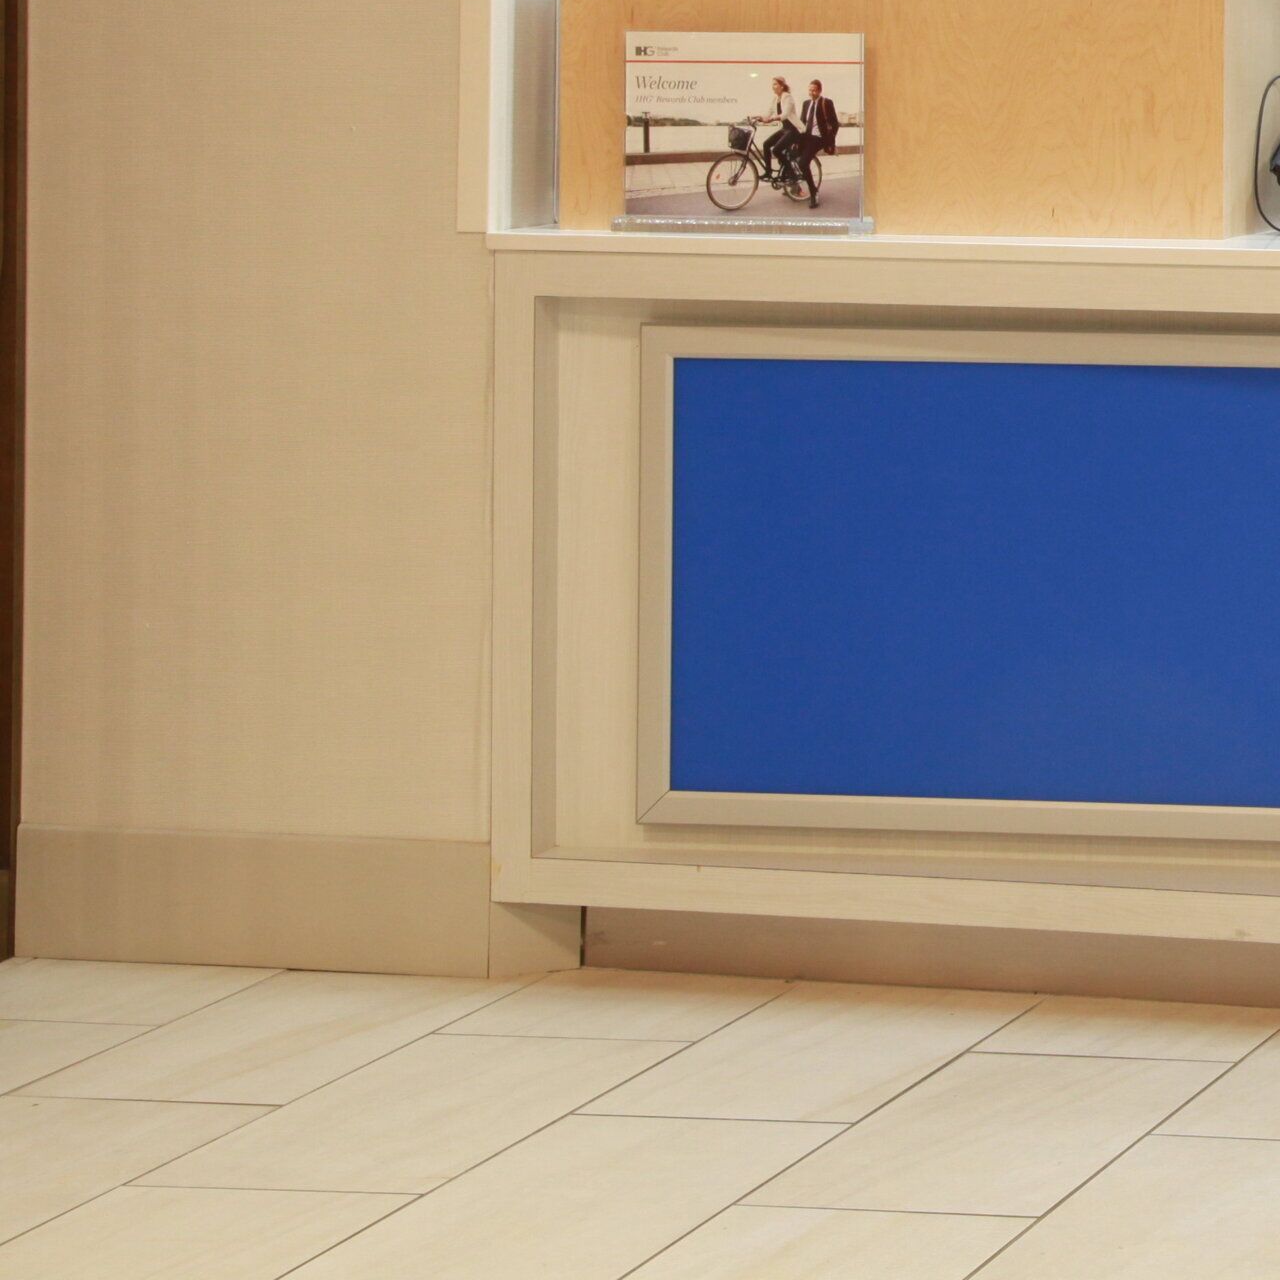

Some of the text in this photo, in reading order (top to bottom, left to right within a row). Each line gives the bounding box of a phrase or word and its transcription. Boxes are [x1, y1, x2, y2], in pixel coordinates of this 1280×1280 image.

[635, 46, 655, 56] IHG
[635, 75, 698, 90] Welcome
[688, 95, 706, 104] Club
